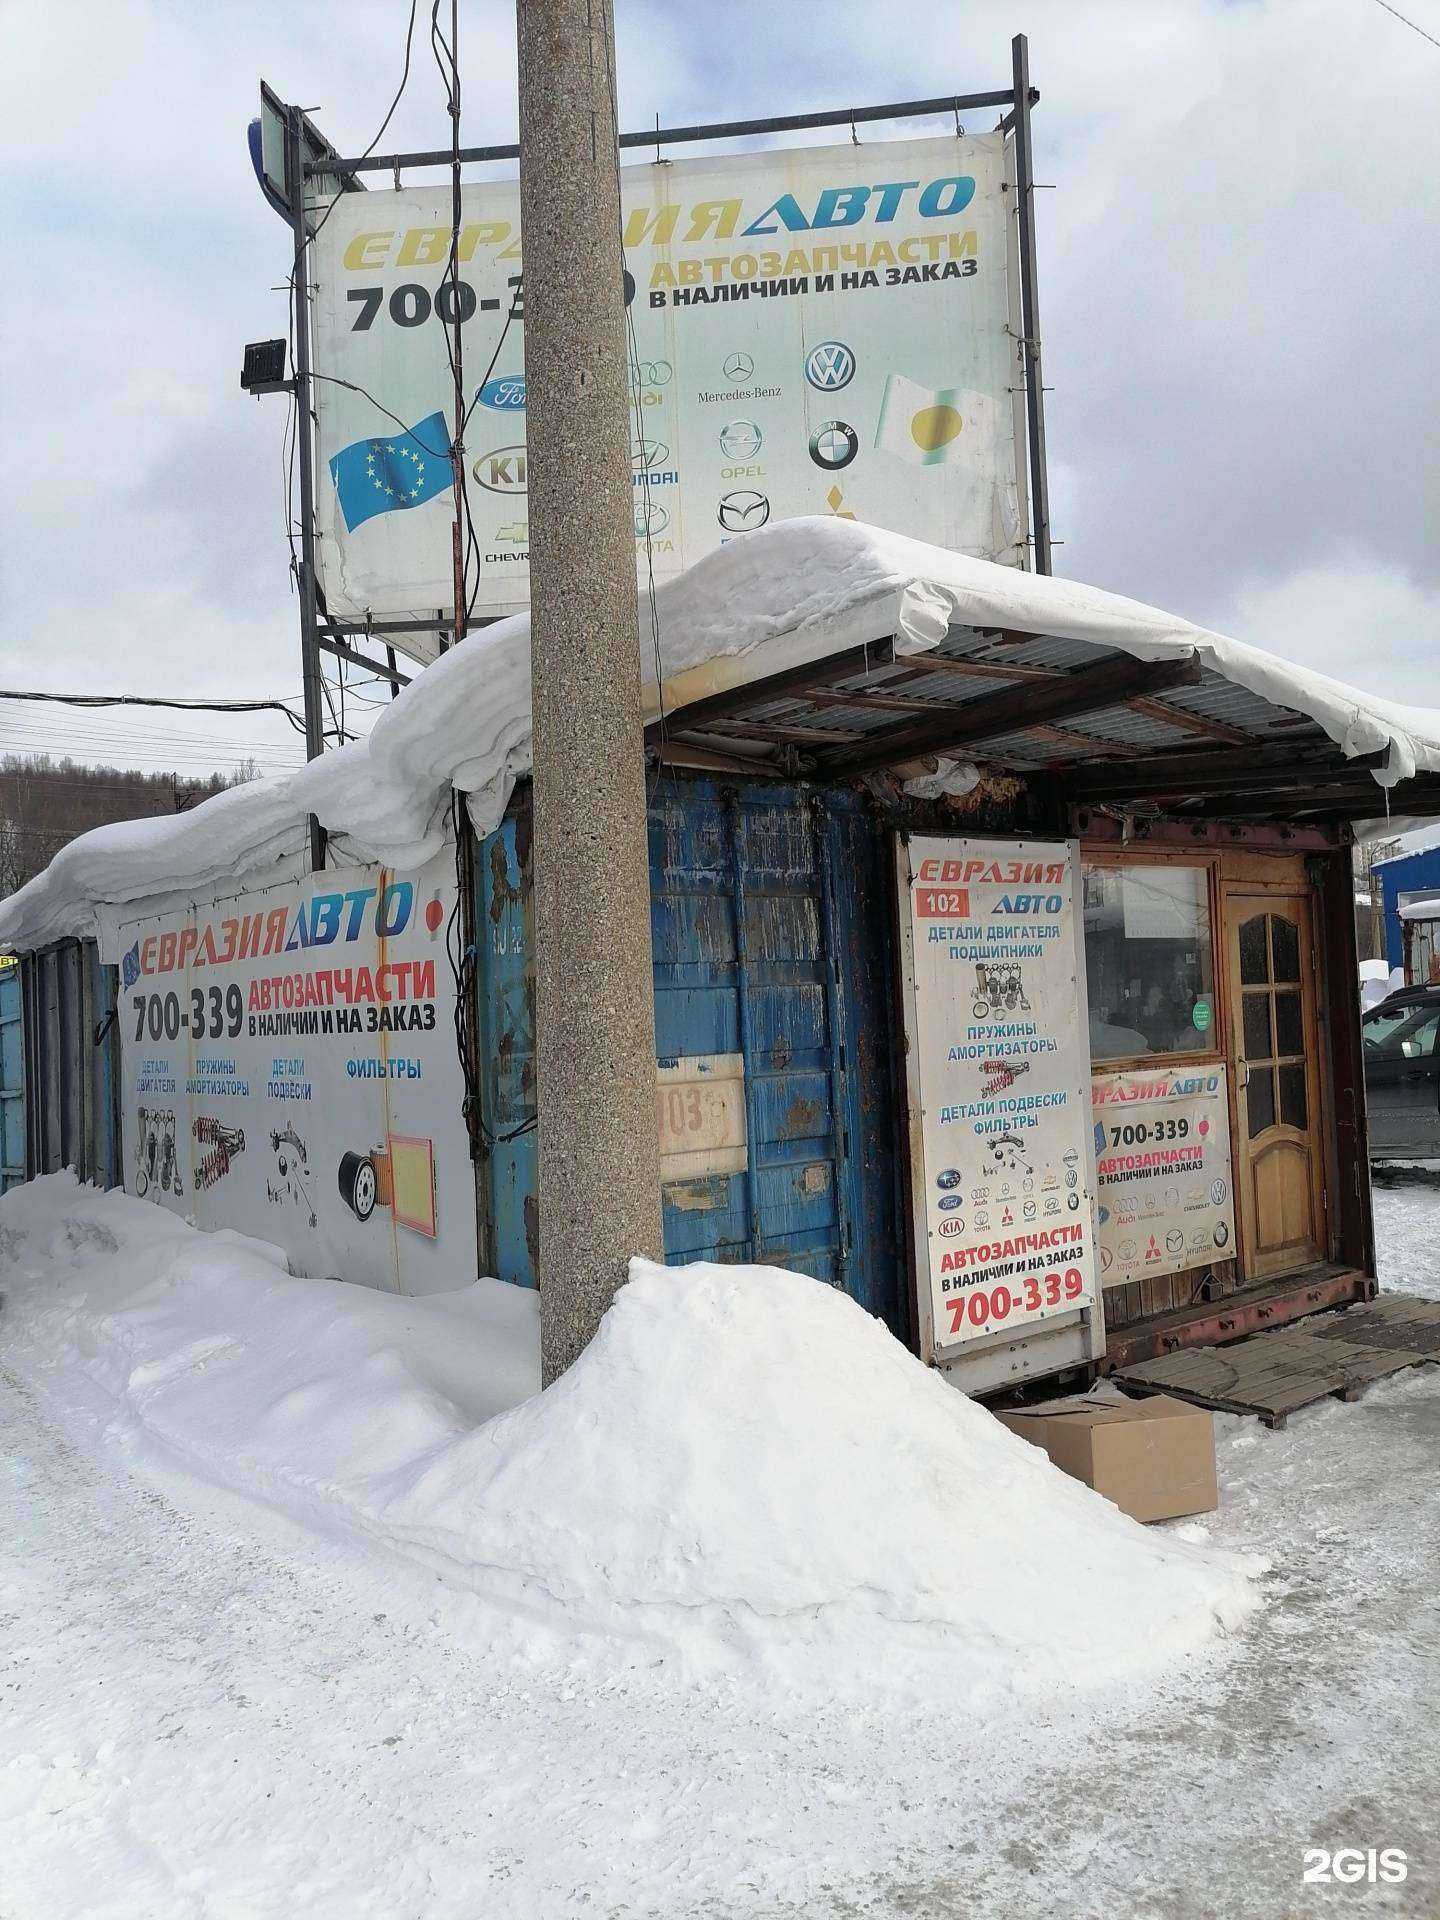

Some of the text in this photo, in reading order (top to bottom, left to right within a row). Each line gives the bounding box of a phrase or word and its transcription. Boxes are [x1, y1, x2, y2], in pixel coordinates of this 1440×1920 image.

[650, 231, 978, 288] АВТОЗАПЧАСТИ
[650, 259, 978, 309] В НАЛИЧИИ И НА ЗАКАЗ
[698, 386, 782, 403] Mercedes-Benz
[721, 466, 767, 479] OPEL
[919, 859, 1066, 884] ЕВРАЗИЯ
[927, 892, 960, 913] 102
[991, 894, 1063, 914] АВТО
[928, 925, 1060, 943] ДЕТАЛИ ДВИГАТЕЛЯ
[950, 944, 1043, 962] ПОДШИПНИКИ
[248, 960, 435, 1012] АВТОЗАПЧАСТИ
[133, 984, 243, 1042] 700-339
[249, 1004, 436, 1037] В НАЛИЧИИ И НА ЗАКАЗ
[967, 1022, 1037, 1040] ПРУЖИНЫ
[948, 1038, 1058, 1061] АМОРТИЗАТОРЫ
[142, 1060, 169, 1075] ДЕТАЛИ
[196, 1059, 236, 1075] ПРУЖИНЫ
[272, 1058, 304, 1078] ДЕТАЛИ
[346, 1057, 421, 1080] ФИЛЬТРЫ
[136, 1078, 176, 1095] ДВИГАТЕЛЯ
[185, 1080, 250, 1097] АМОРТИЗАТОРЫ
[267, 1081, 312, 1102] ПОДВЕСКИ
[940, 1092, 1067, 1124] ДЕТАЛИ ПОДВЕСКИ
[973, 1113, 1039, 1135] ФИЛЬТРЫ
[1110, 1118, 1190, 1148] 700-339
[1097, 1145, 1203, 1174] АВТОЗАПЧАСТИ
[1106, 1168, 1152, 1185] НАЛИЧИИ
[1153, 1166, 1160, 1177] И
[1161, 1164, 1174, 1176] НА
[1175, 1160, 1203, 1174] ЗАКАЗ
[973, 1199, 988, 1207] Audi
[942, 1221, 961, 1234] KIA
[1116, 1213, 1136, 1226] Audi
[940, 1223, 1083, 1273] АВТОЗАПЧАСТИ
[942, 1280, 951, 1293] В
[953, 1263, 1014, 1290] НАЛИЧИИ
[1016, 1260, 1026, 1273] И
[1028, 1254, 1045, 1271] НА
[1047, 1246, 1084, 1267] ЗАКАЗ
[1116, 1260, 1141, 1271] TOYOTA
[946, 1267, 1083, 1335] 700-339
